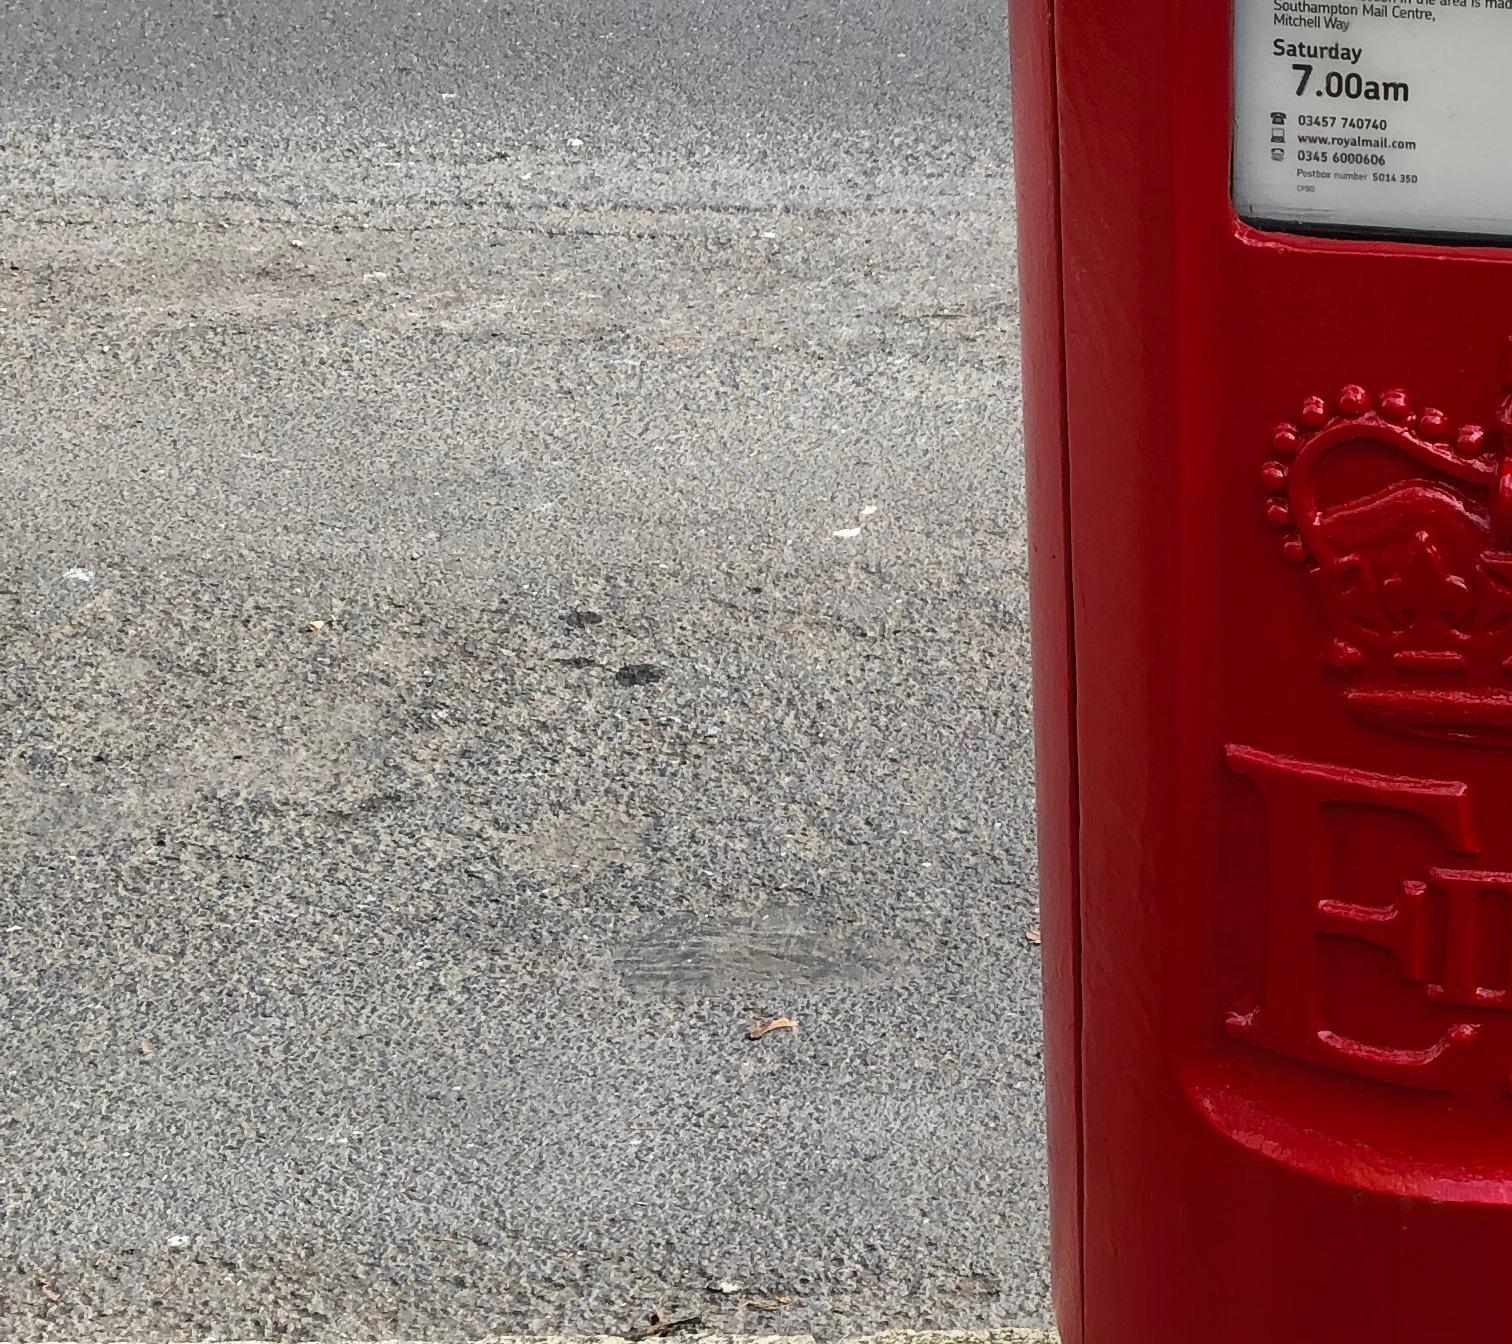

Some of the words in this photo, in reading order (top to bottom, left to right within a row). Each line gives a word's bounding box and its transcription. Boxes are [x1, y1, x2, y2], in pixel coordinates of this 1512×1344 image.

[1362, 4, 1388, 18] Mail
[1391, 6, 1436, 22] Centre,
[1273, 13, 1321, 29] Mitchell
[1323, 16, 1350, 32] Way
[1273, 38, 1363, 65] Saturday
[1292, 63, 1409, 102] 7.00am
[1297, 114, 1337, 128] 03457
[1341, 117, 1388, 131] 740740
[1297, 135, 1417, 150] www.royalmail.com
[1297, 149, 1328, 163] 0345
[1332, 152, 1386, 166] 6000606
[1296, 168, 1331, 179] Postbox
[1334, 172, 1367, 181] number
